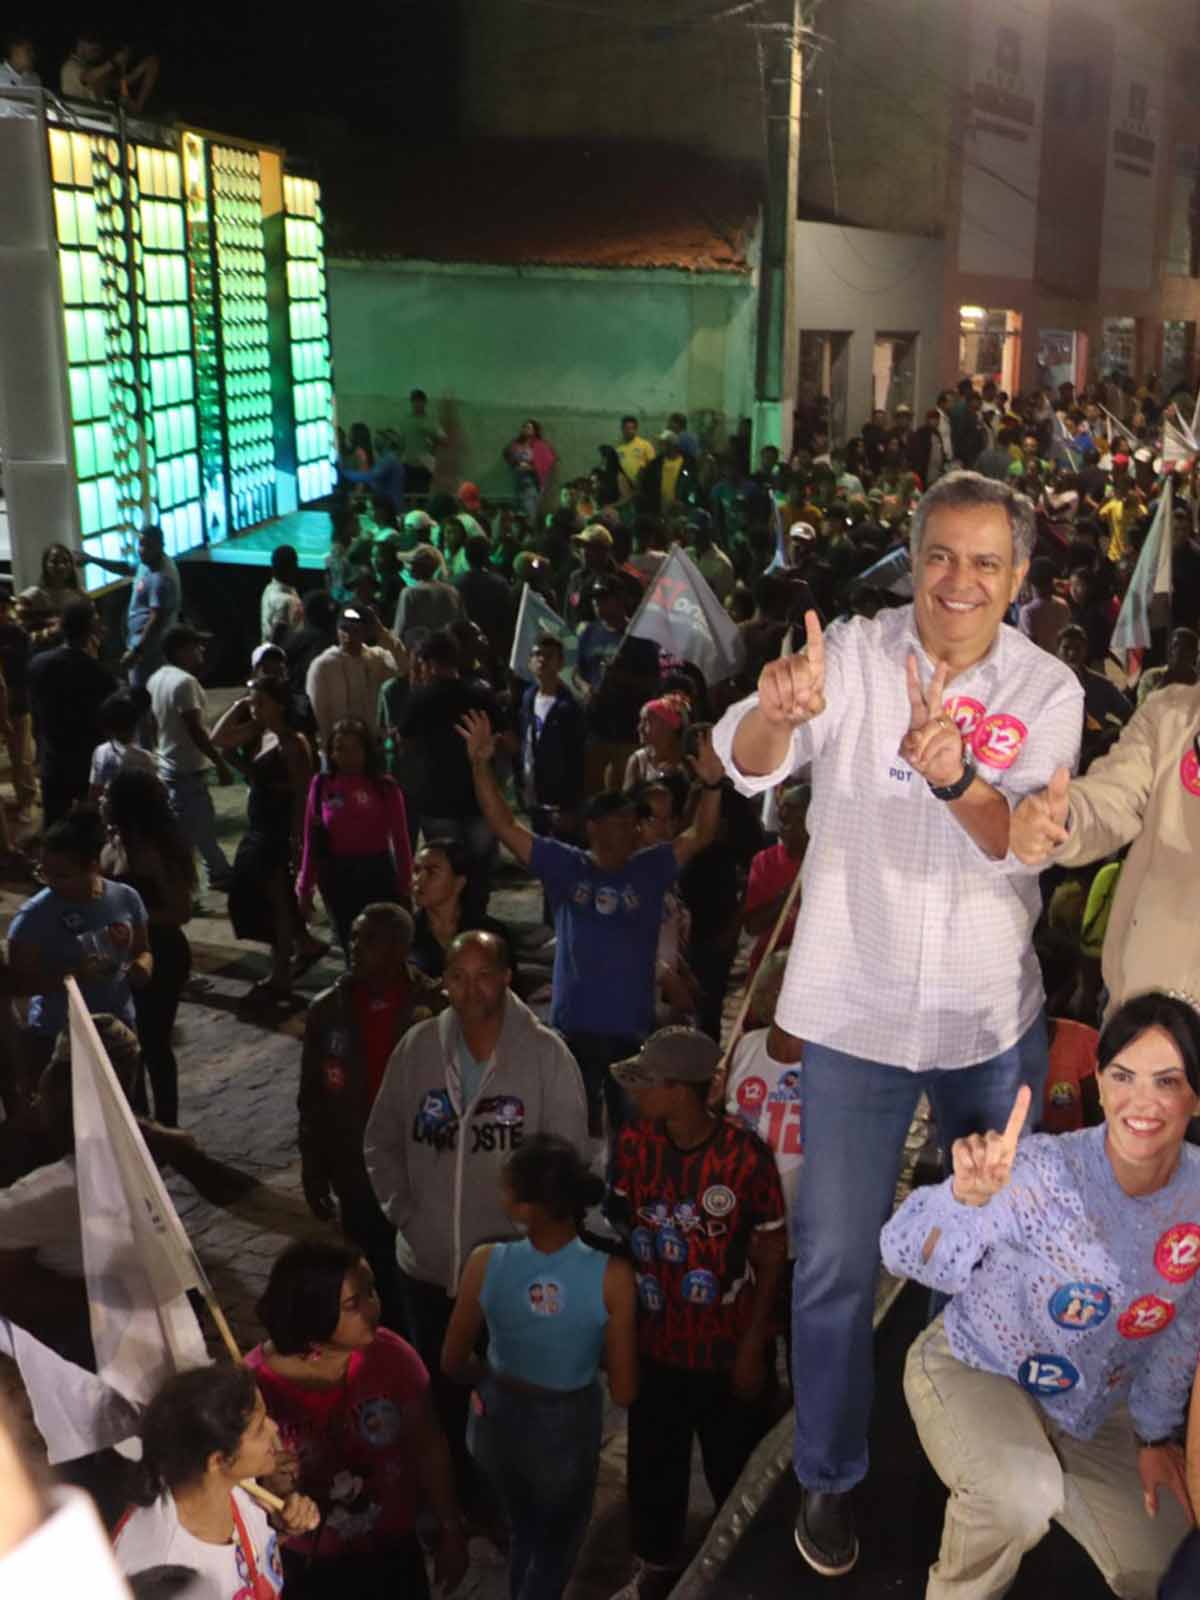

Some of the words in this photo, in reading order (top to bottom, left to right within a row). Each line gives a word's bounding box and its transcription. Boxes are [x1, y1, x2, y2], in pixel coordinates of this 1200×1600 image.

[987, 726, 1020, 754] 12
[889, 768, 913, 783] PDT
[1170, 1234, 1200, 1265] 12
[1134, 1308, 1162, 1328] 12
[1027, 1360, 1064, 1386] 12
